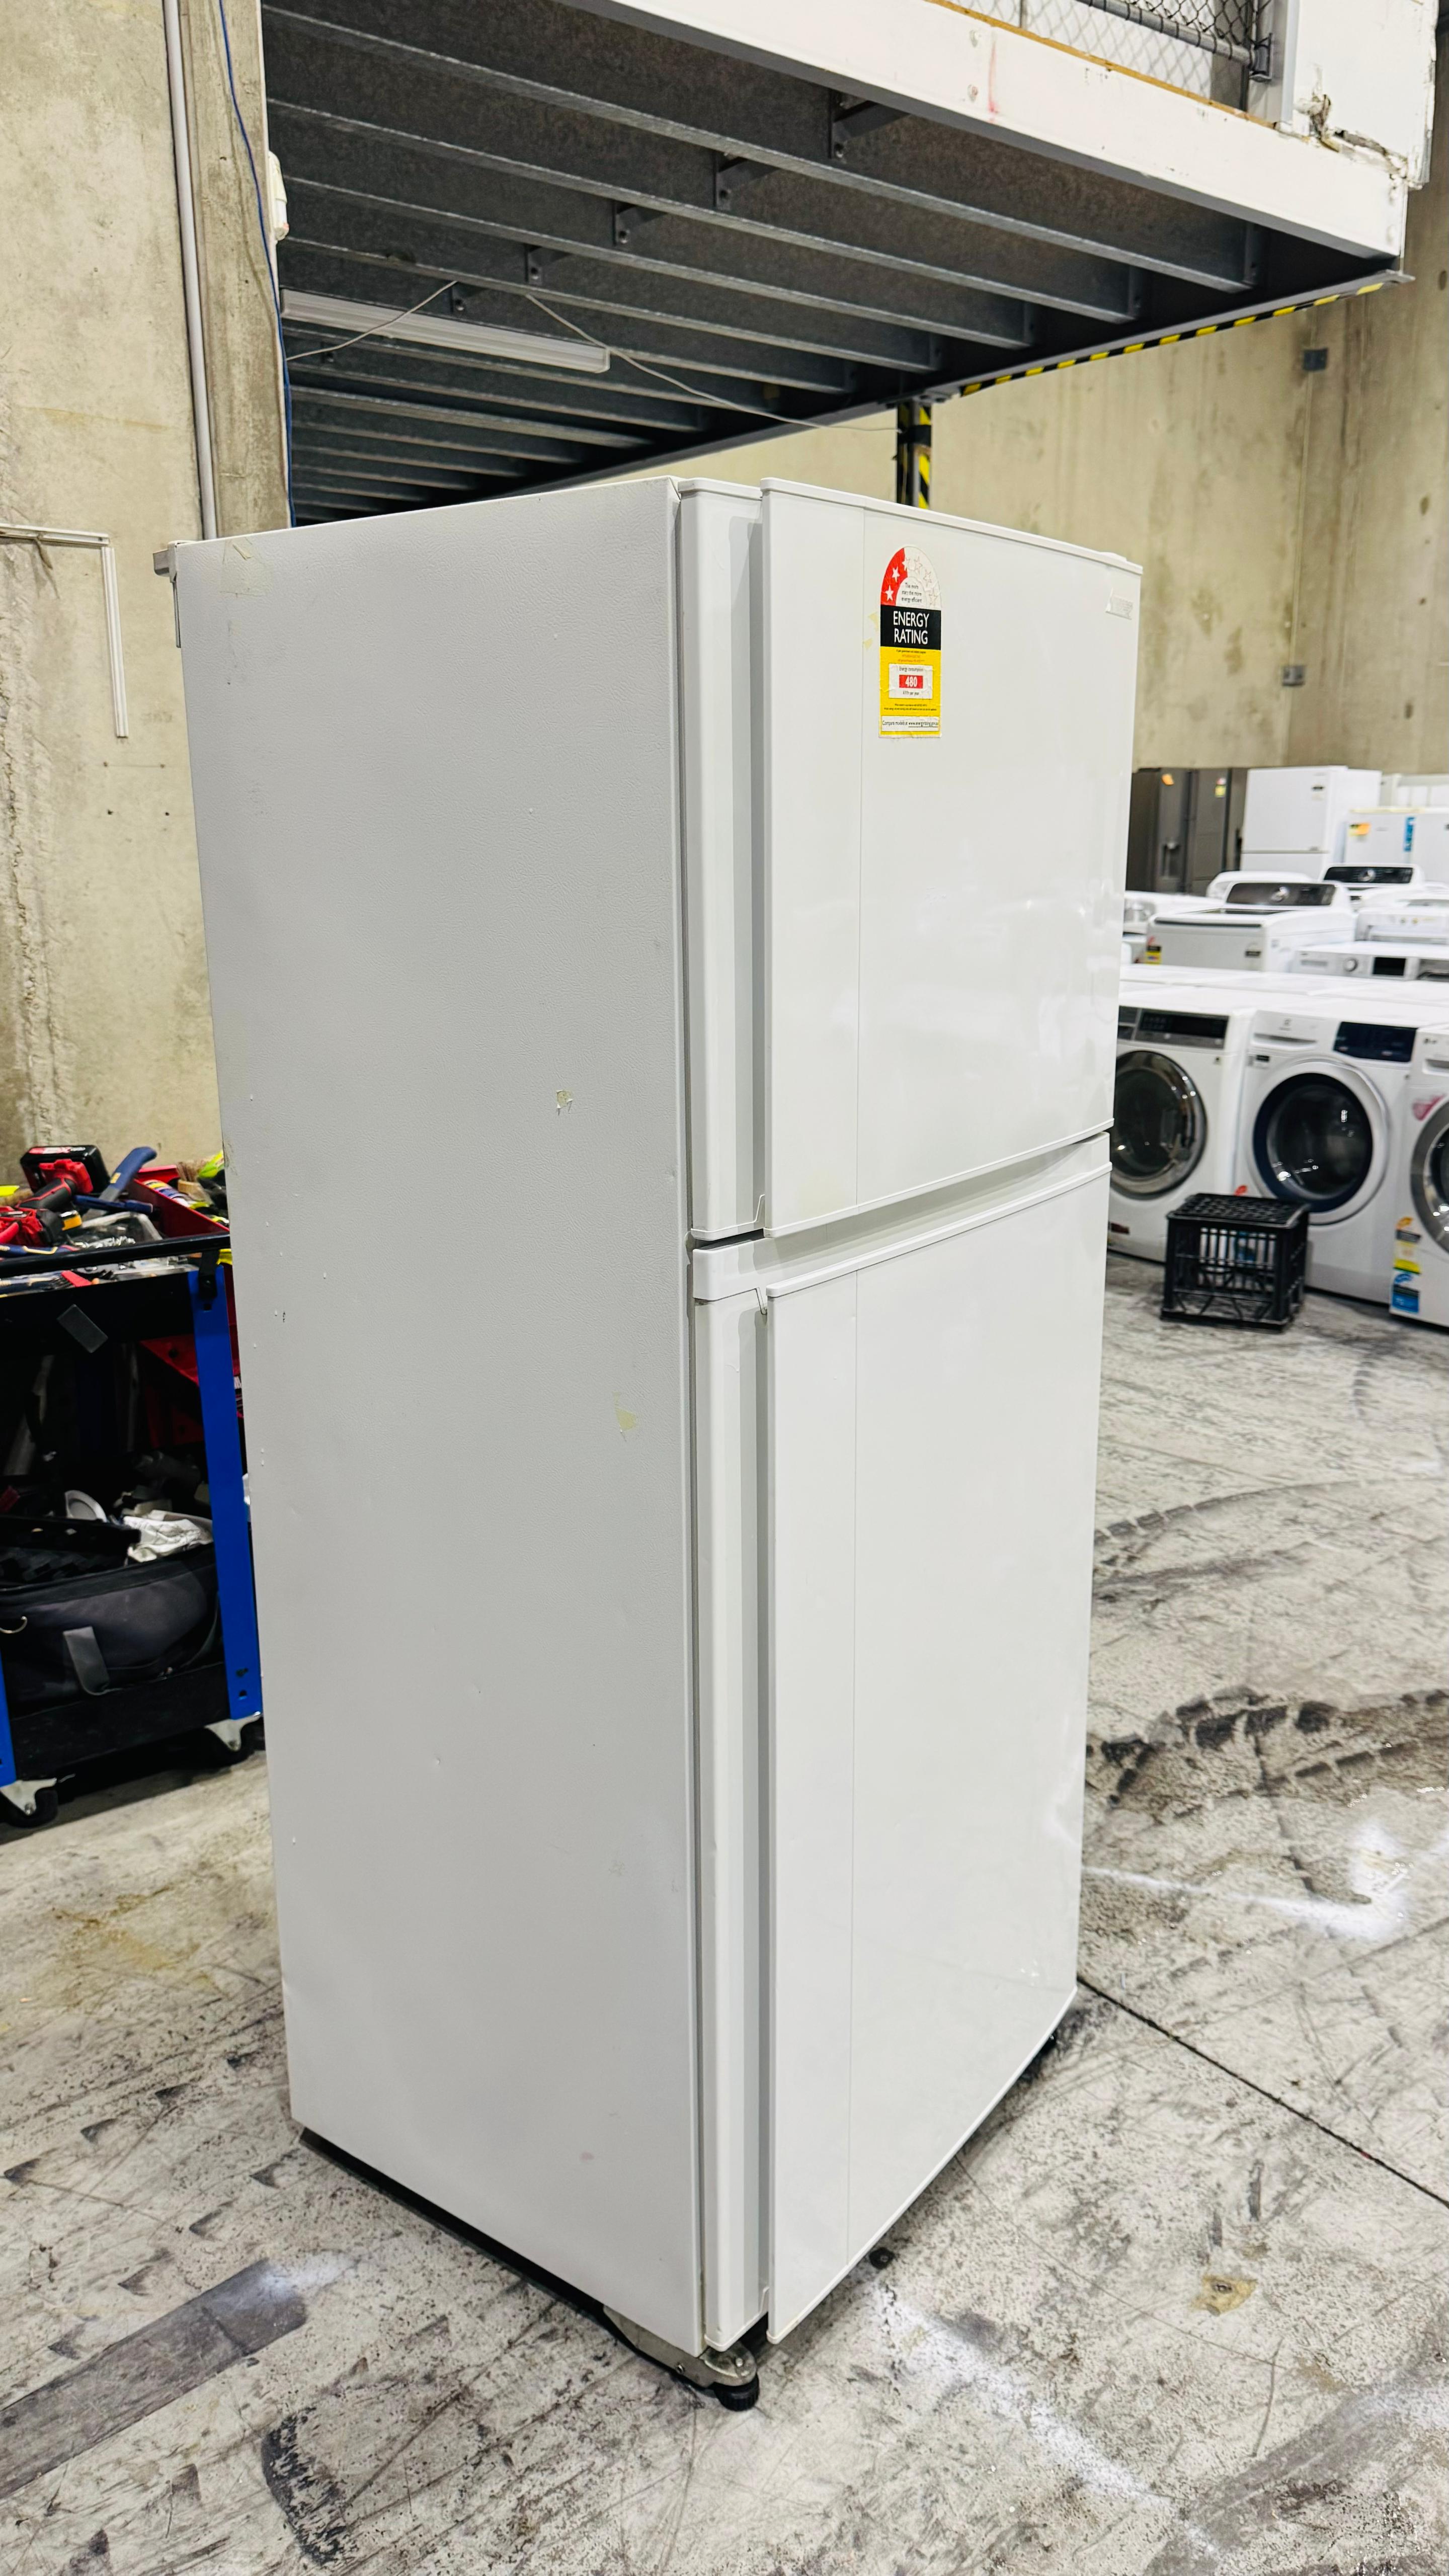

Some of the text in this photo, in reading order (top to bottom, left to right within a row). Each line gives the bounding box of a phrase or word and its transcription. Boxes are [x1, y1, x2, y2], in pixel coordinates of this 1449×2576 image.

[893, 610, 930, 628] ENERGY
[894, 628, 928, 645] RATING
[905, 676, 918, 687] 480
